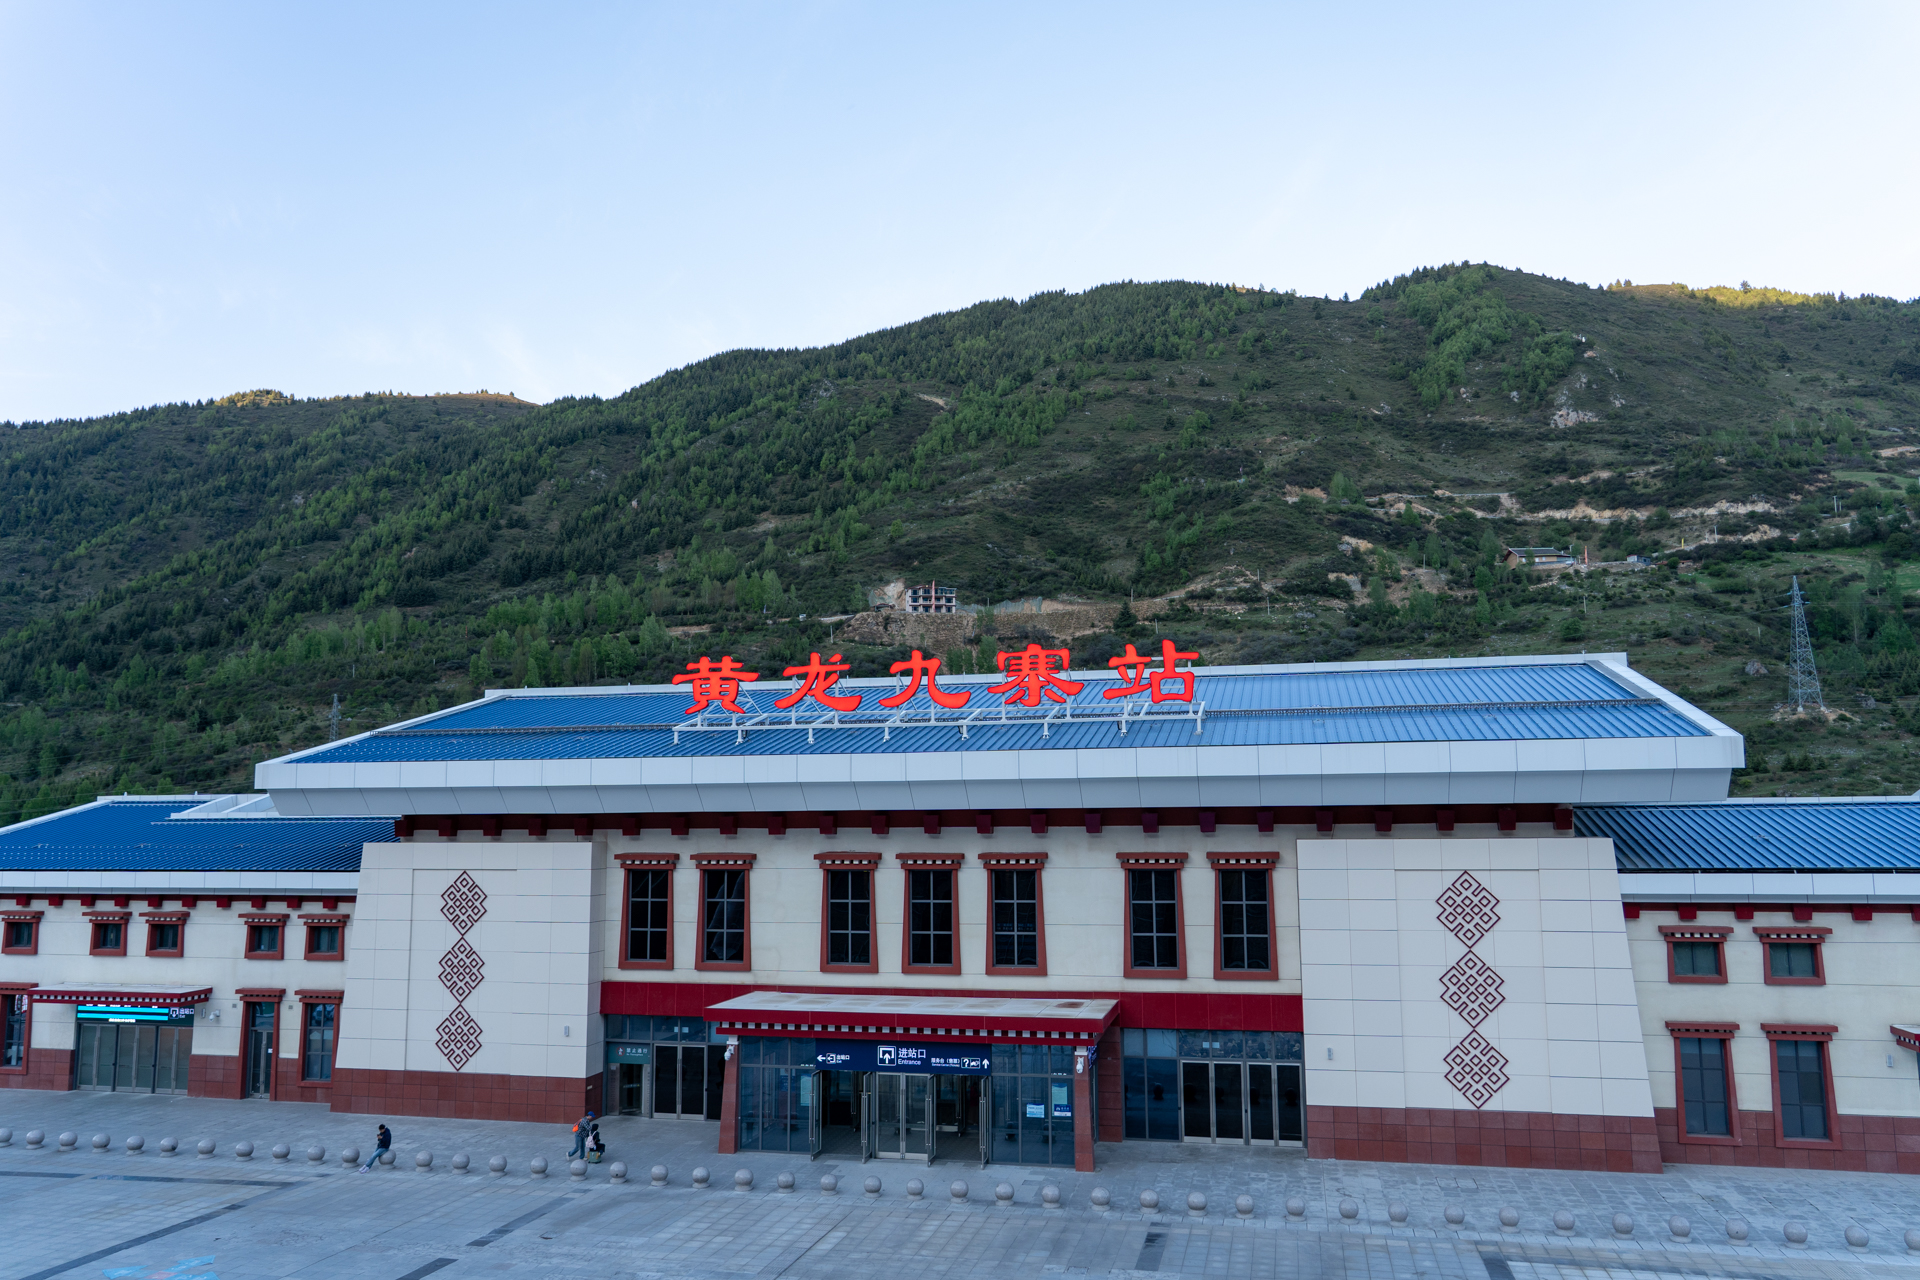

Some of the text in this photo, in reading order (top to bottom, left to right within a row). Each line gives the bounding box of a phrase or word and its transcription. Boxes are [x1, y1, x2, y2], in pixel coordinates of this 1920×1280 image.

[672, 639, 1199, 715] 黄龙九寨站
[898, 1047, 926, 1059] 进站口
[898, 1058, 921, 1066] Entrance
